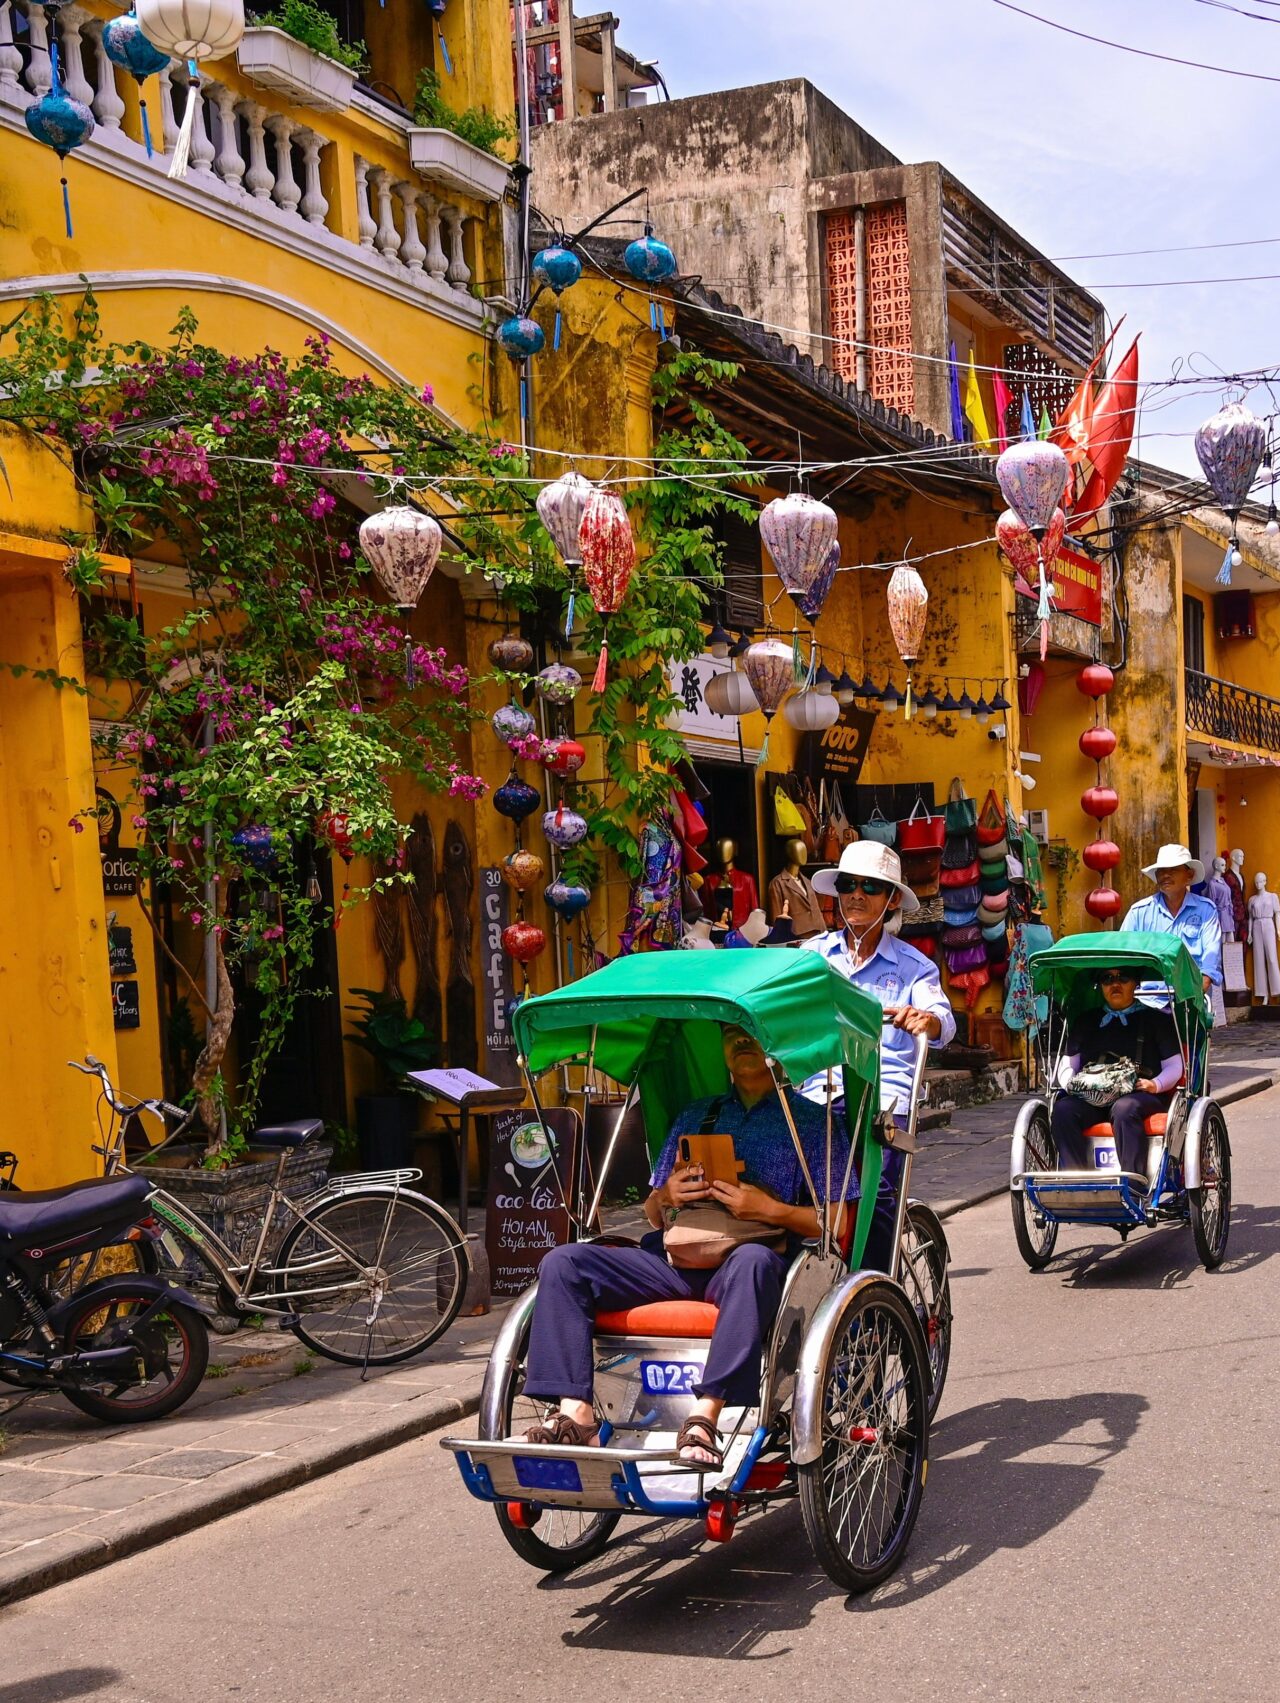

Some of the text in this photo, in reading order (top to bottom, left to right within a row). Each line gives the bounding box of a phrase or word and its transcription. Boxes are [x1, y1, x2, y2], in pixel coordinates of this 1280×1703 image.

[113, 883, 133, 891] CAFE
[486, 870, 501, 885] 30
[501, 1217, 547, 1237] HOI AN
[498, 1231, 557, 1253] Style noodle
[646, 1364, 703, 1391] 023
